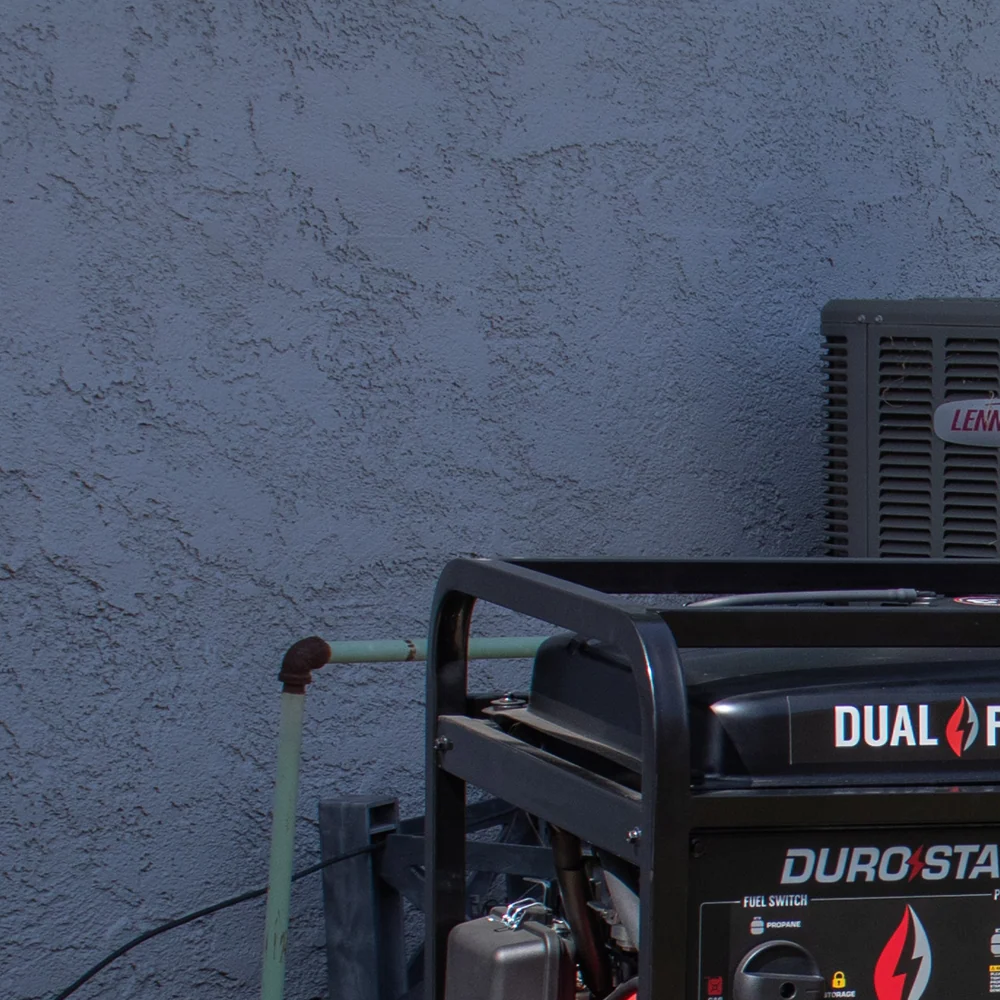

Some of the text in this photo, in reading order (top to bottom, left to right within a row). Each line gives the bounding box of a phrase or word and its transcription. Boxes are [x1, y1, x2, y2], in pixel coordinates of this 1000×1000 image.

[834, 705, 939, 748] DUAL
[743, 894, 808, 908] FUEL SWITCH
[766, 920, 802, 928] PROPANE
